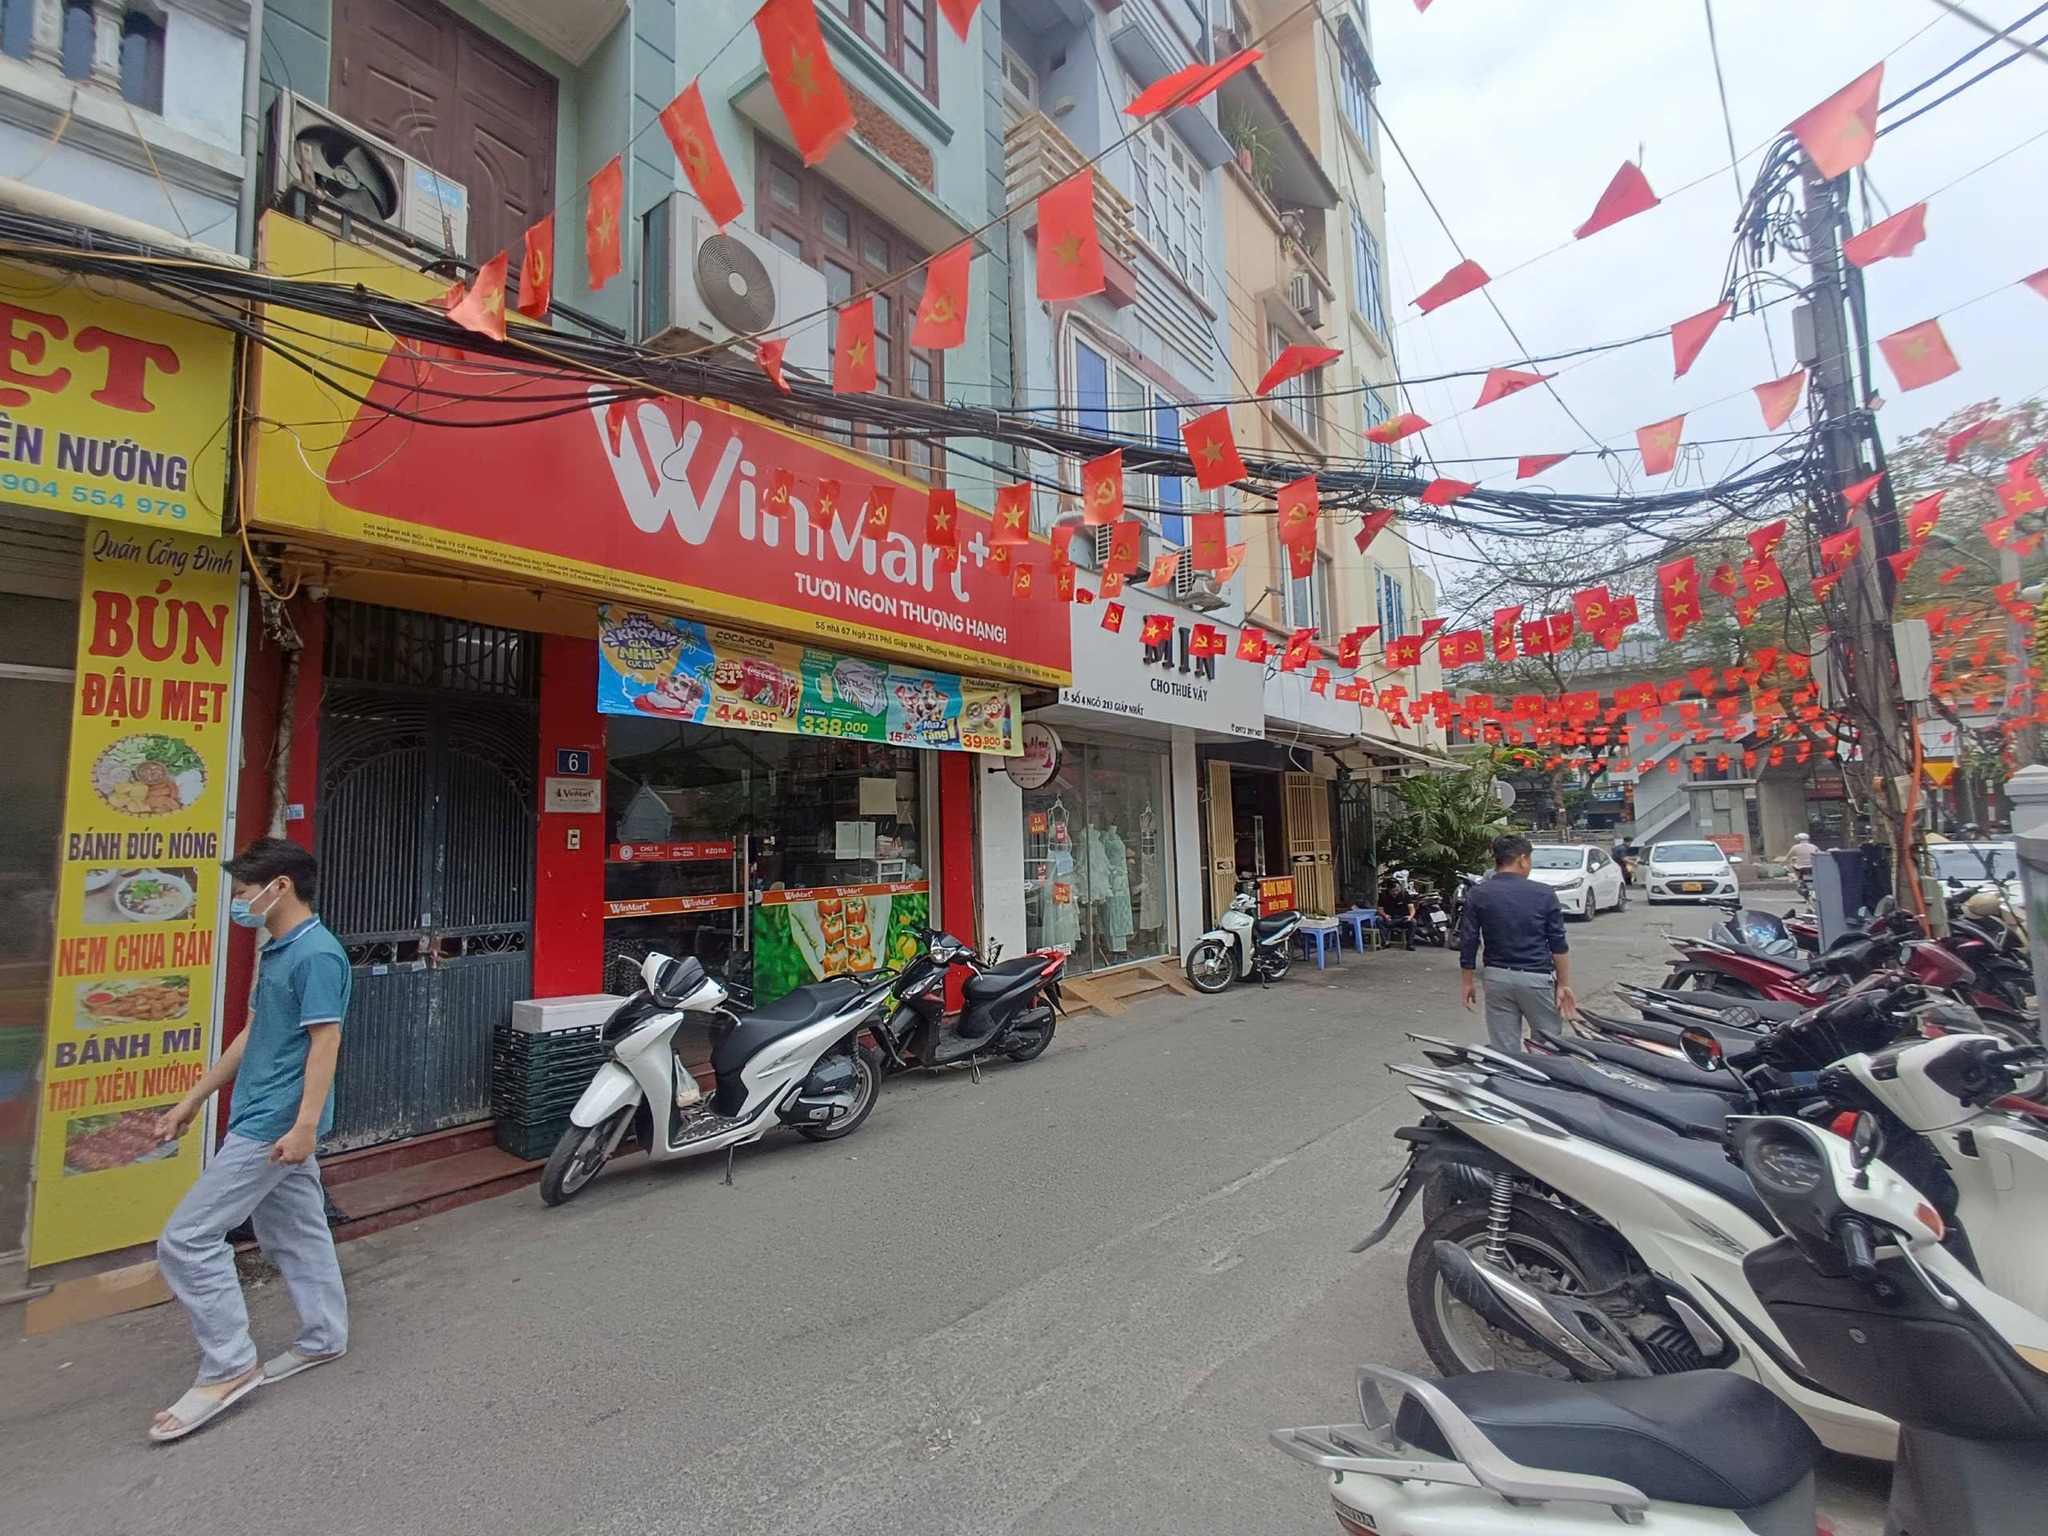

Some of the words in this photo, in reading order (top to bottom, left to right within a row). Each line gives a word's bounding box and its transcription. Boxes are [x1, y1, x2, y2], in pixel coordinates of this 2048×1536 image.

[57, 432, 188, 492] NƯỚNG
[72, 487, 125, 509] 554
[136, 498, 187, 519] 979
[92, 529, 142, 562] Quán
[192, 544, 233, 575] Đình
[88, 579, 230, 667] BÚN
[794, 571, 842, 602] TƯƠI
[845, 587, 898, 617] NGON
[899, 598, 964, 632] THƯỢNG
[966, 618, 1007, 644] HẠNG!
[715, 630, 775, 650] COCA-COLA
[815, 621, 826, 630] Số
[827, 623, 840, 632] nhà
[841, 626, 851, 635] 67
[868, 631, 880, 641] 213
[82, 666, 152, 727] ĐẬU
[160, 679, 228, 732] MẸT
[1071, 690, 1081, 704] SỐ
[1082, 696, 1086, 705] 4
[1102, 699, 1113, 710] 213
[1114, 700, 1128, 713] GIÁP
[1150, 678, 1170, 695] CHO
[1171, 682, 1192, 698] THUÊ
[1193, 685, 1209, 702] VÁY
[568, 753, 579, 771] 6
[68, 827, 122, 861] BÁNH
[126, 828, 163, 860] ĐÚC
[168, 828, 217, 860] NÓNG
[57, 936, 108, 977] NEM
[114, 929, 166, 973] CHUA
[171, 924, 213, 968] RÁN
[54, 1033, 151, 1068] BÁNH
[162, 1025, 202, 1054] MÌ
[49, 1077, 89, 1116] THỊT
[93, 1067, 138, 1106] XIÊN
[142, 1059, 203, 1098] NƯỚNG
